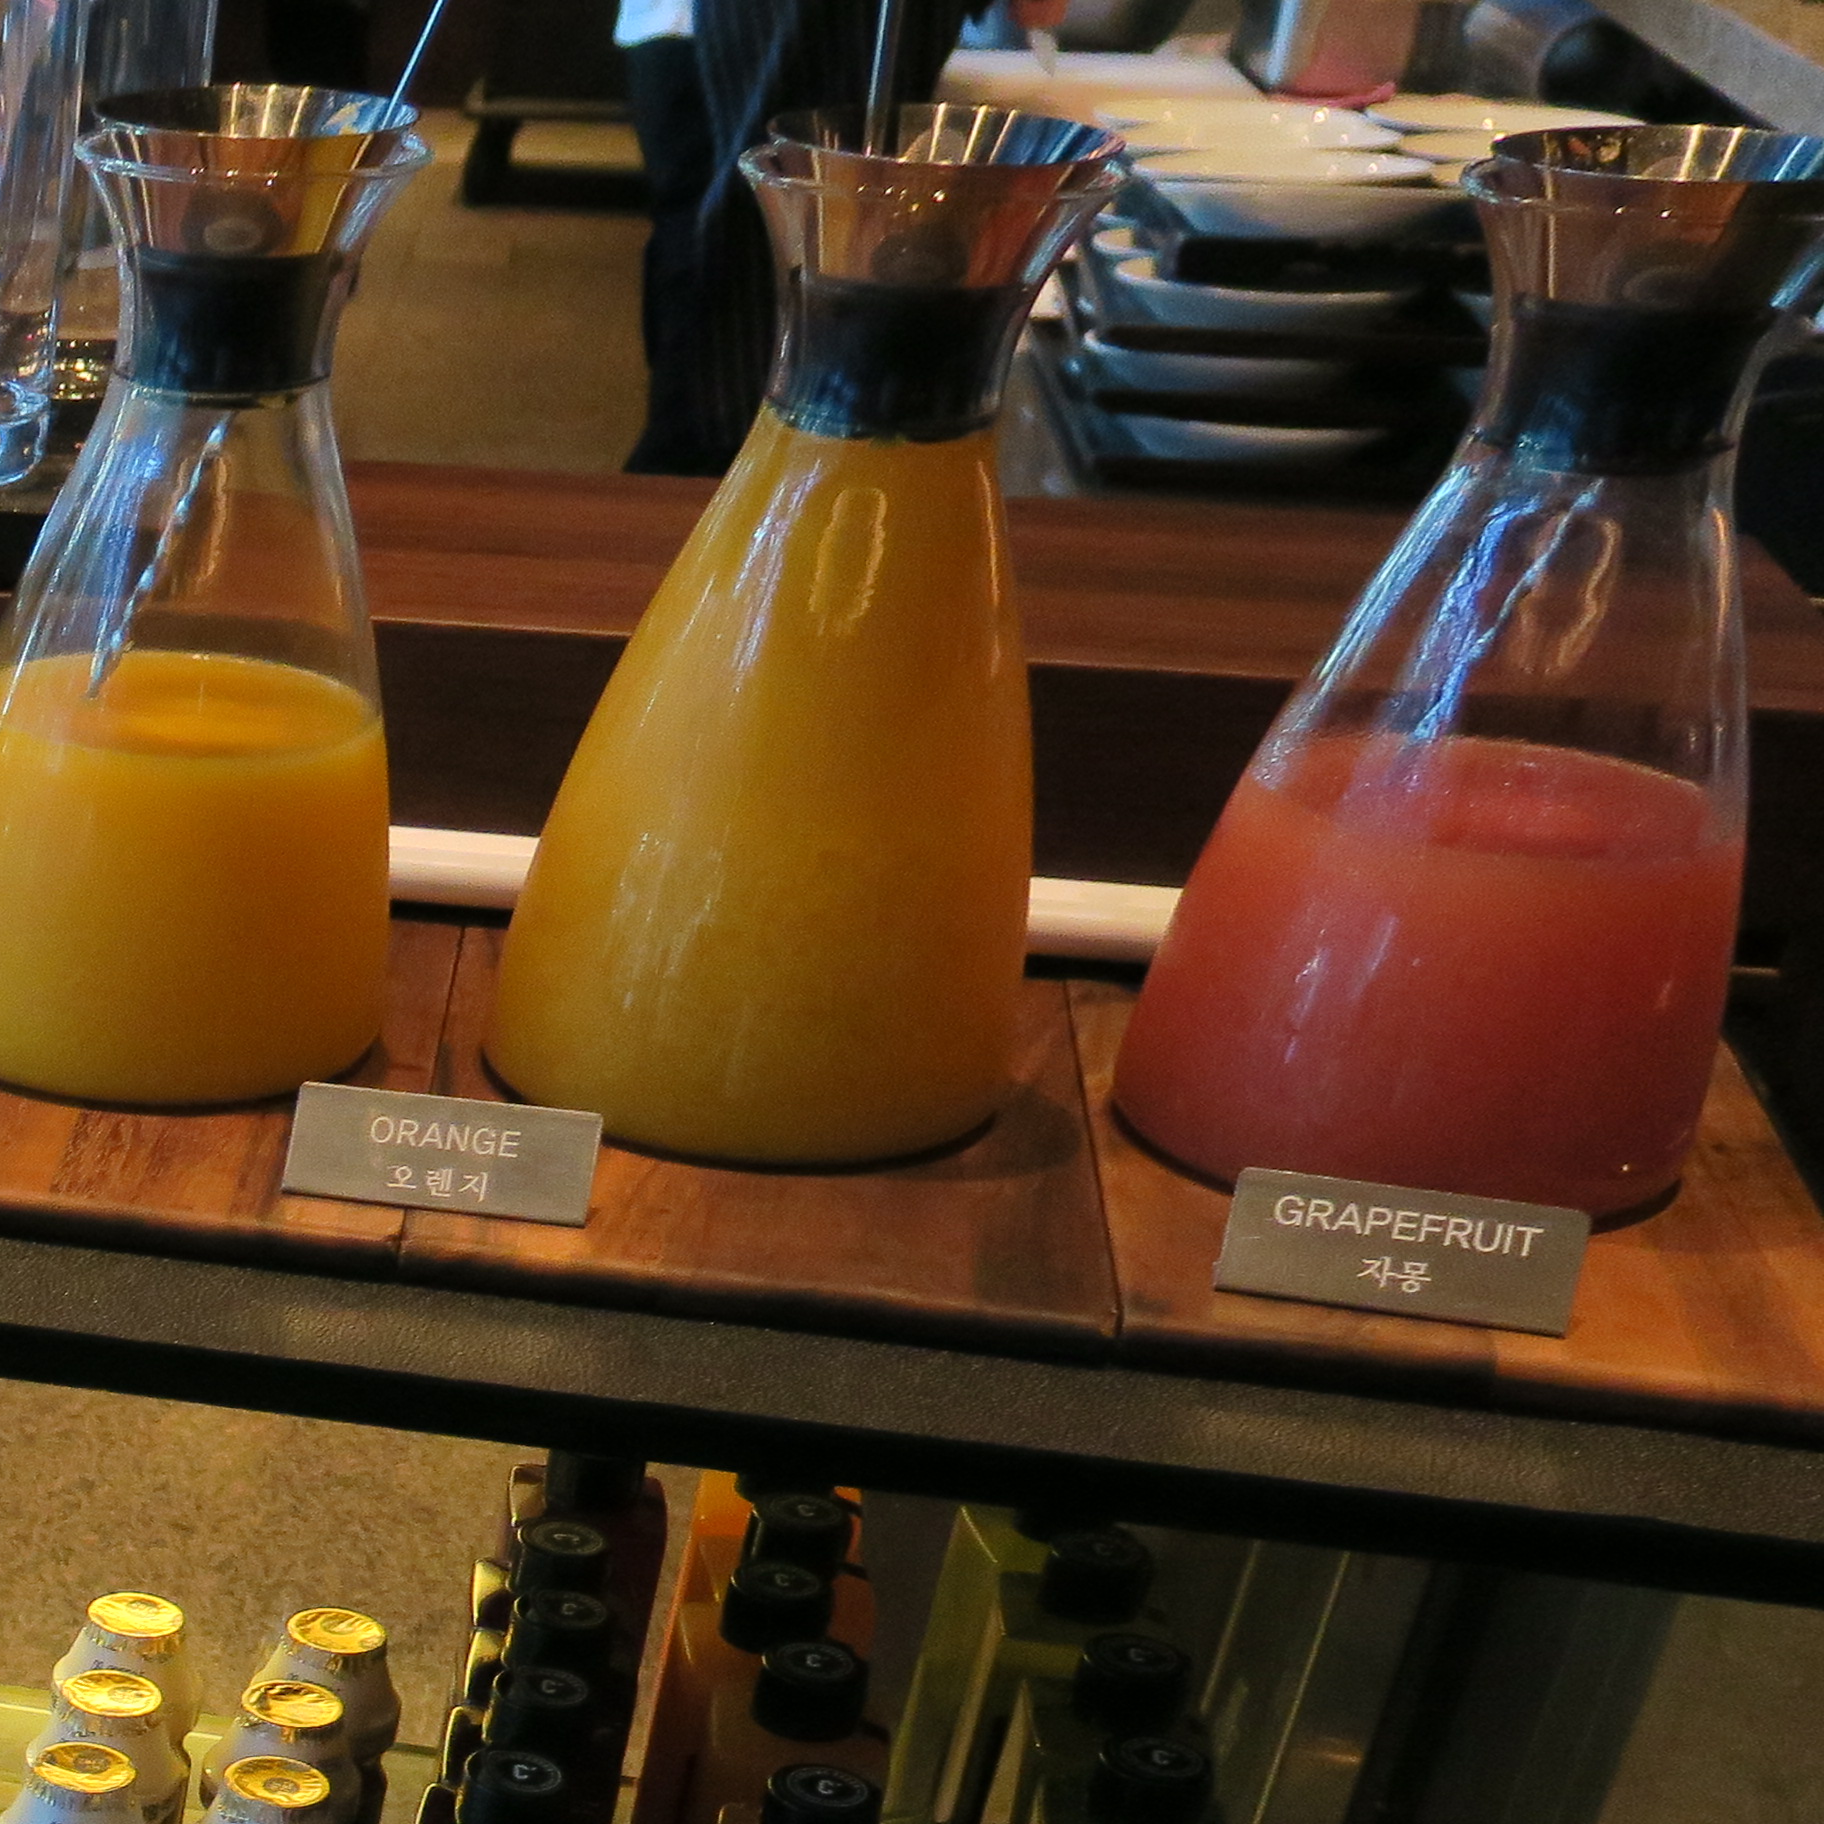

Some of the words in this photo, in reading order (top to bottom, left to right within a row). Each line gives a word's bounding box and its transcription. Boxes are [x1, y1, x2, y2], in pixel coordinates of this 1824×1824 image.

[370, 1115, 522, 1159] ORANGE
[385, 1165, 490, 1203] 오렌지
[1273, 1194, 1545, 1257] GRAPEFRUIT
[1355, 1255, 1432, 1293] 자몽
